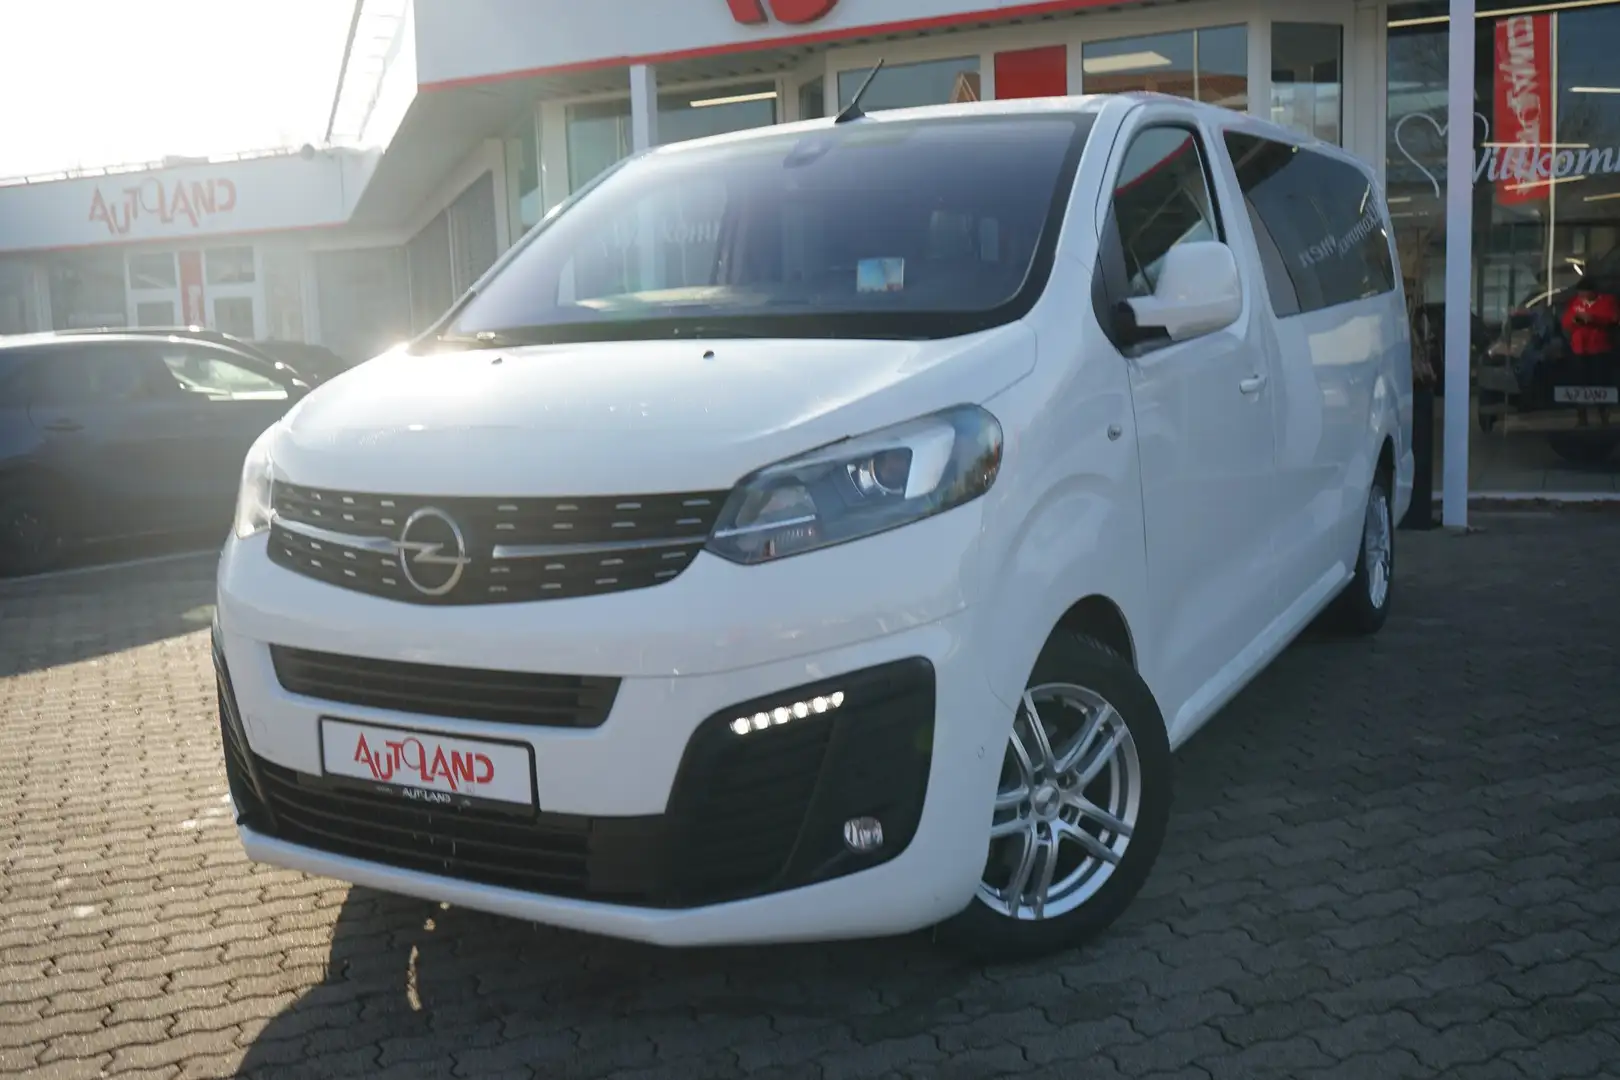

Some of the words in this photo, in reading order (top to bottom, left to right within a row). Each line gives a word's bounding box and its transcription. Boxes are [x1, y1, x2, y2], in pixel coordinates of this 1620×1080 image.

[1472, 143, 1620, 184] illkom
[88, 177, 237, 234] AUTOLAND
[354, 731, 495, 791] AUTOLAND
